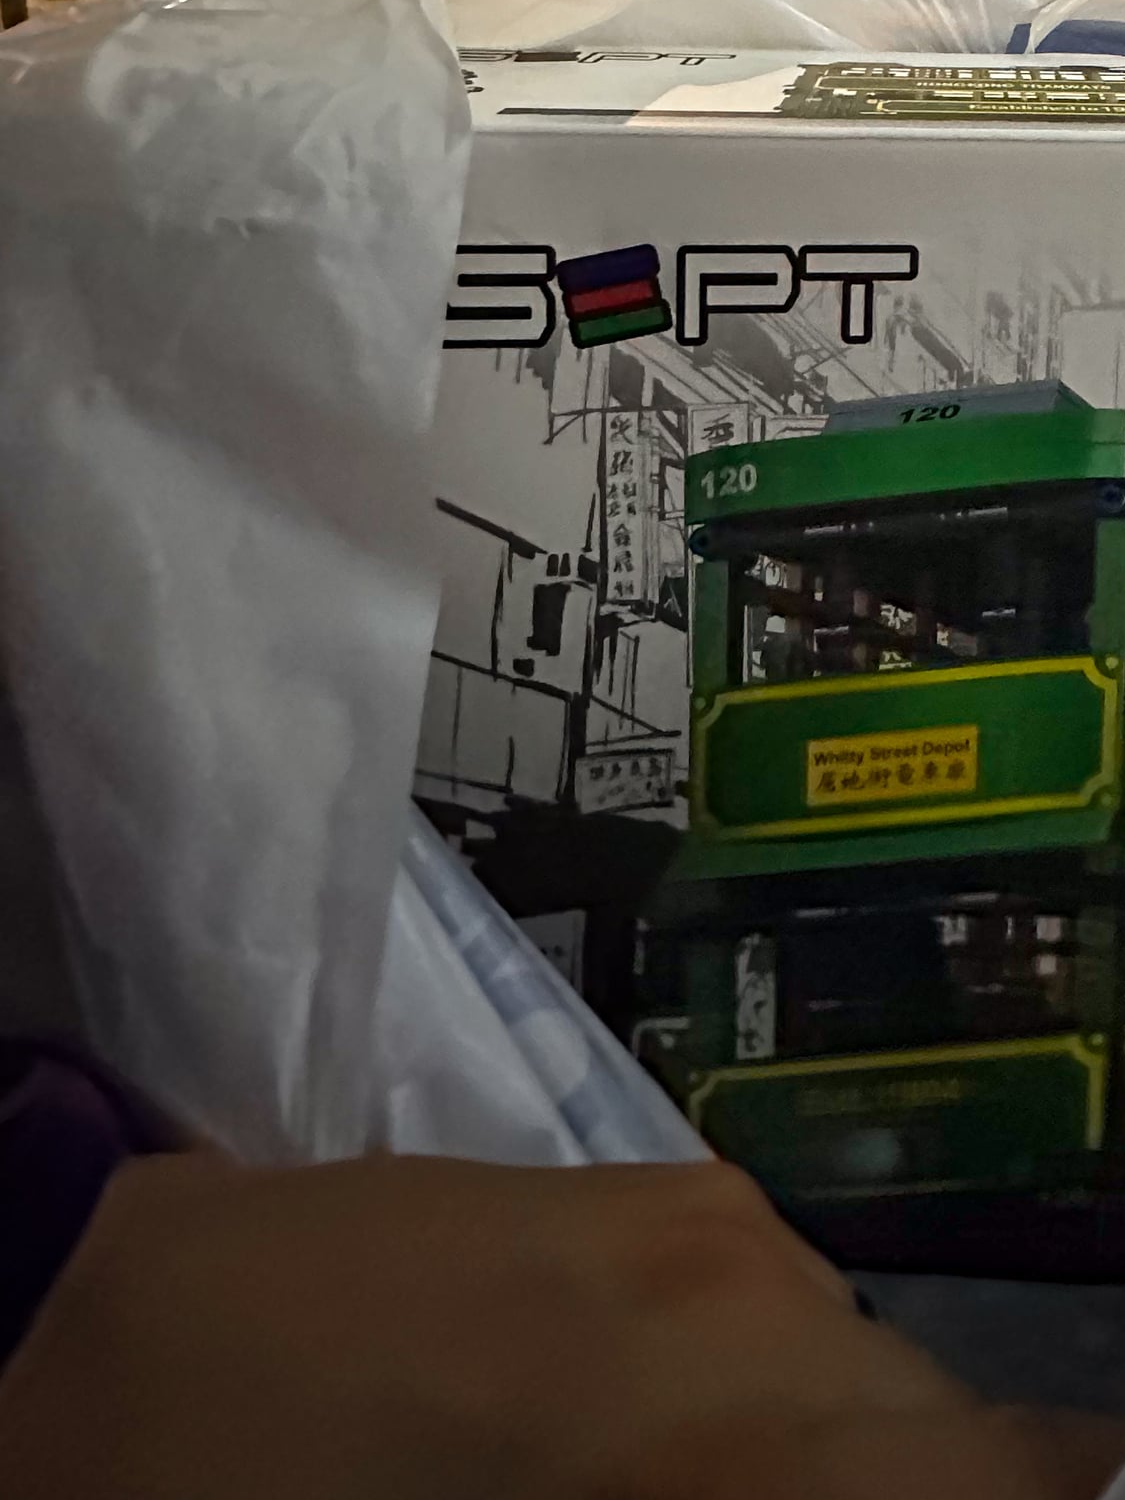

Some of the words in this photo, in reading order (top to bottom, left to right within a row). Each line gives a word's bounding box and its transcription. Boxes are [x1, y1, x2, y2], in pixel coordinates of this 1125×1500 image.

[899, 404, 962, 425] 120
[701, 463, 758, 499] 120
[869, 744, 918, 761] Street
[921, 738, 970, 757] Depot
